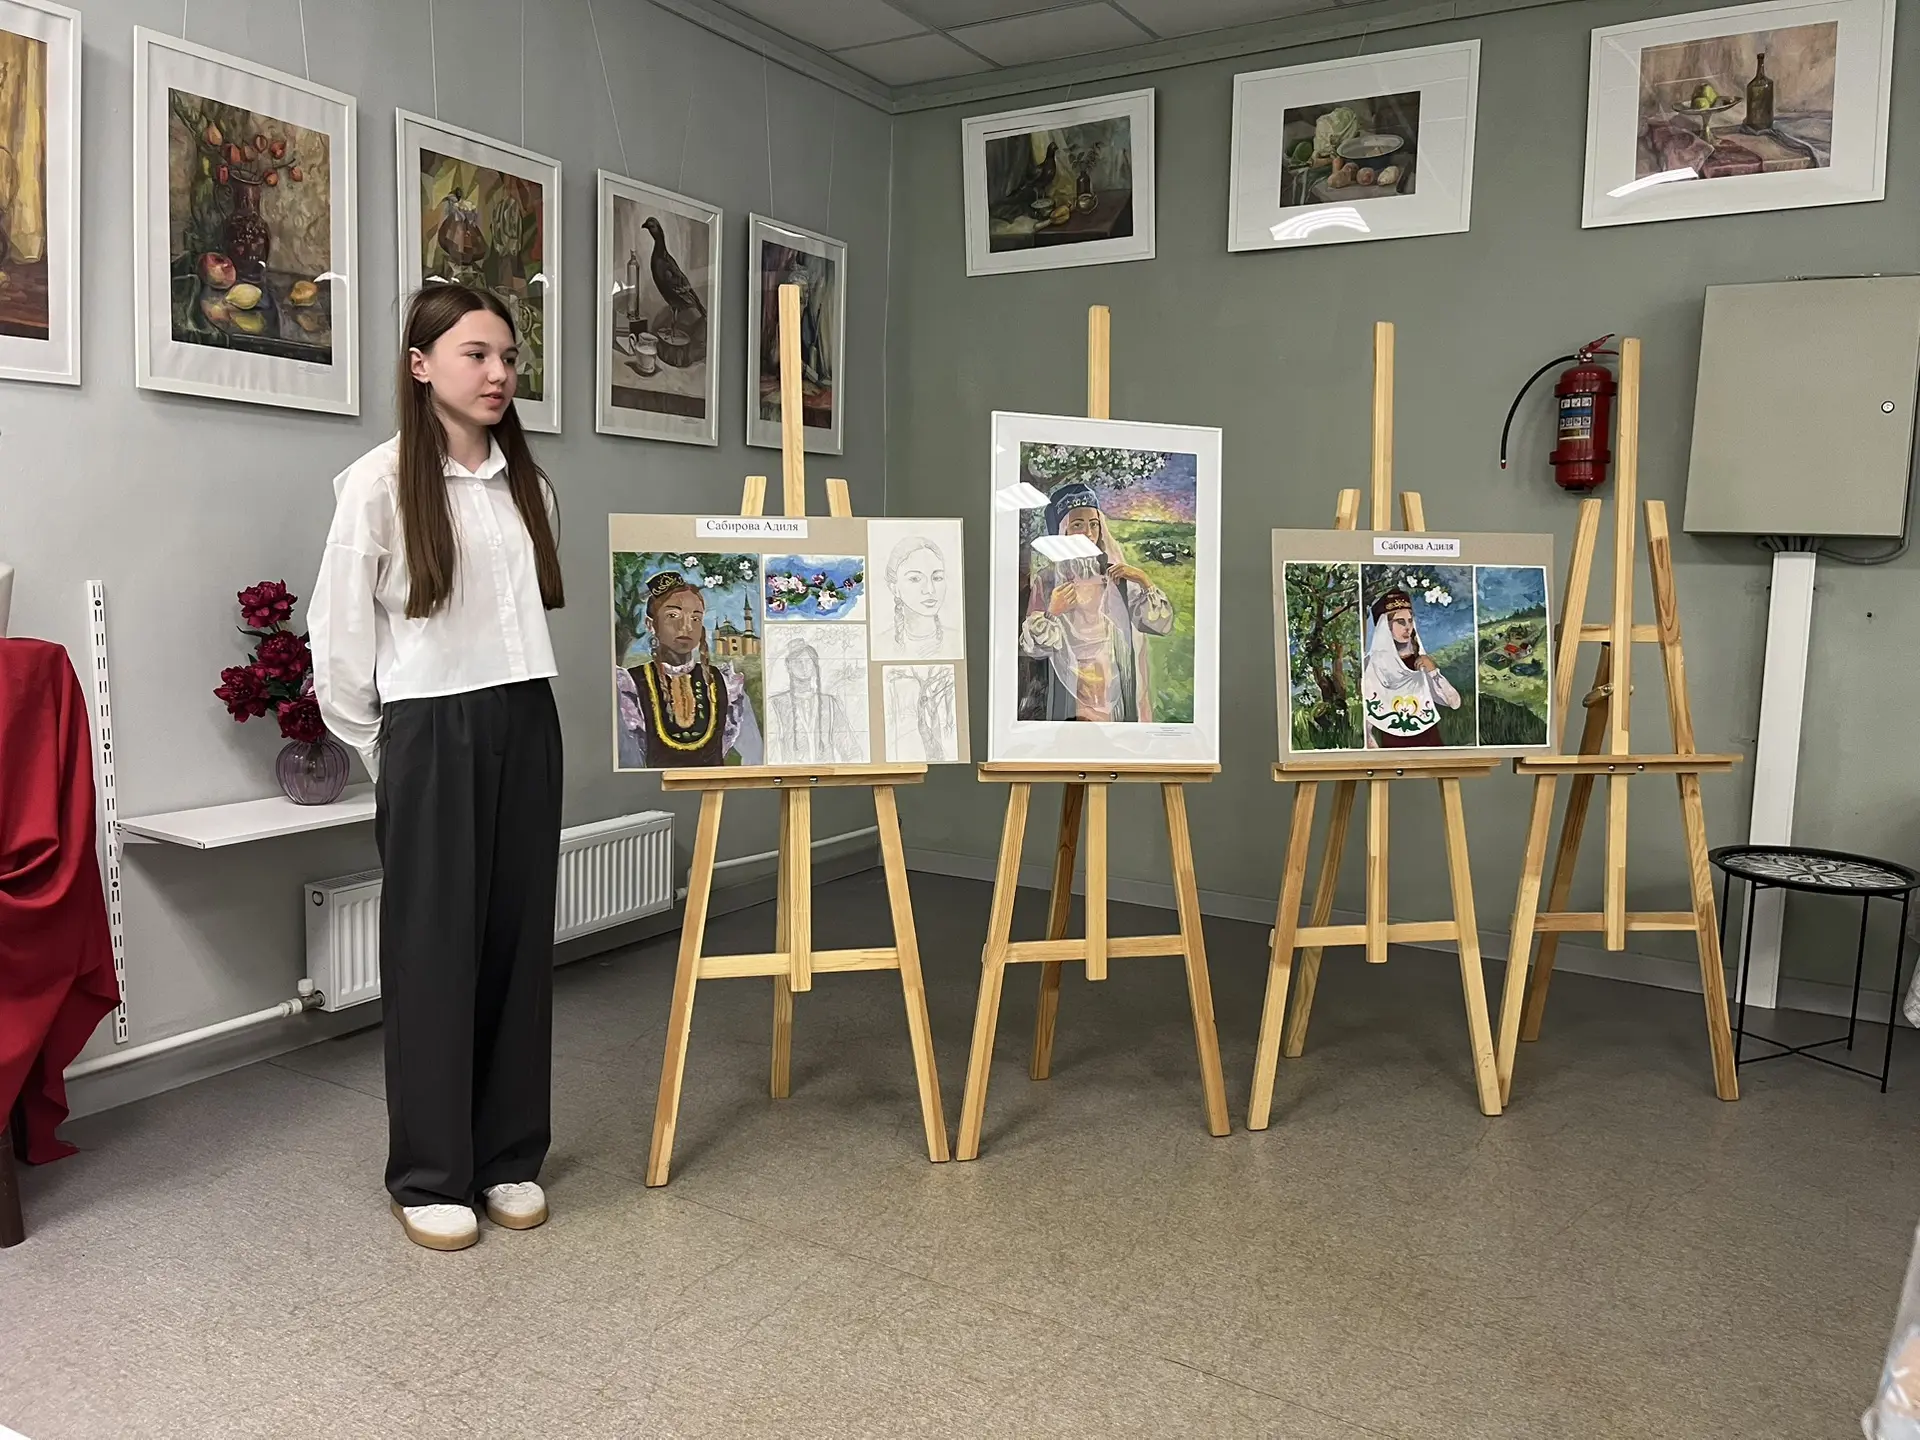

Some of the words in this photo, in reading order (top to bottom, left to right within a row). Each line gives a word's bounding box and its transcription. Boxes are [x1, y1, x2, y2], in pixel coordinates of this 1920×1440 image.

[706, 520, 760, 533] Сабирова
[763, 521, 799, 532] Адиля
[1381, 541, 1424, 552] Сабирова
[1426, 542, 1454, 551] Адиля
